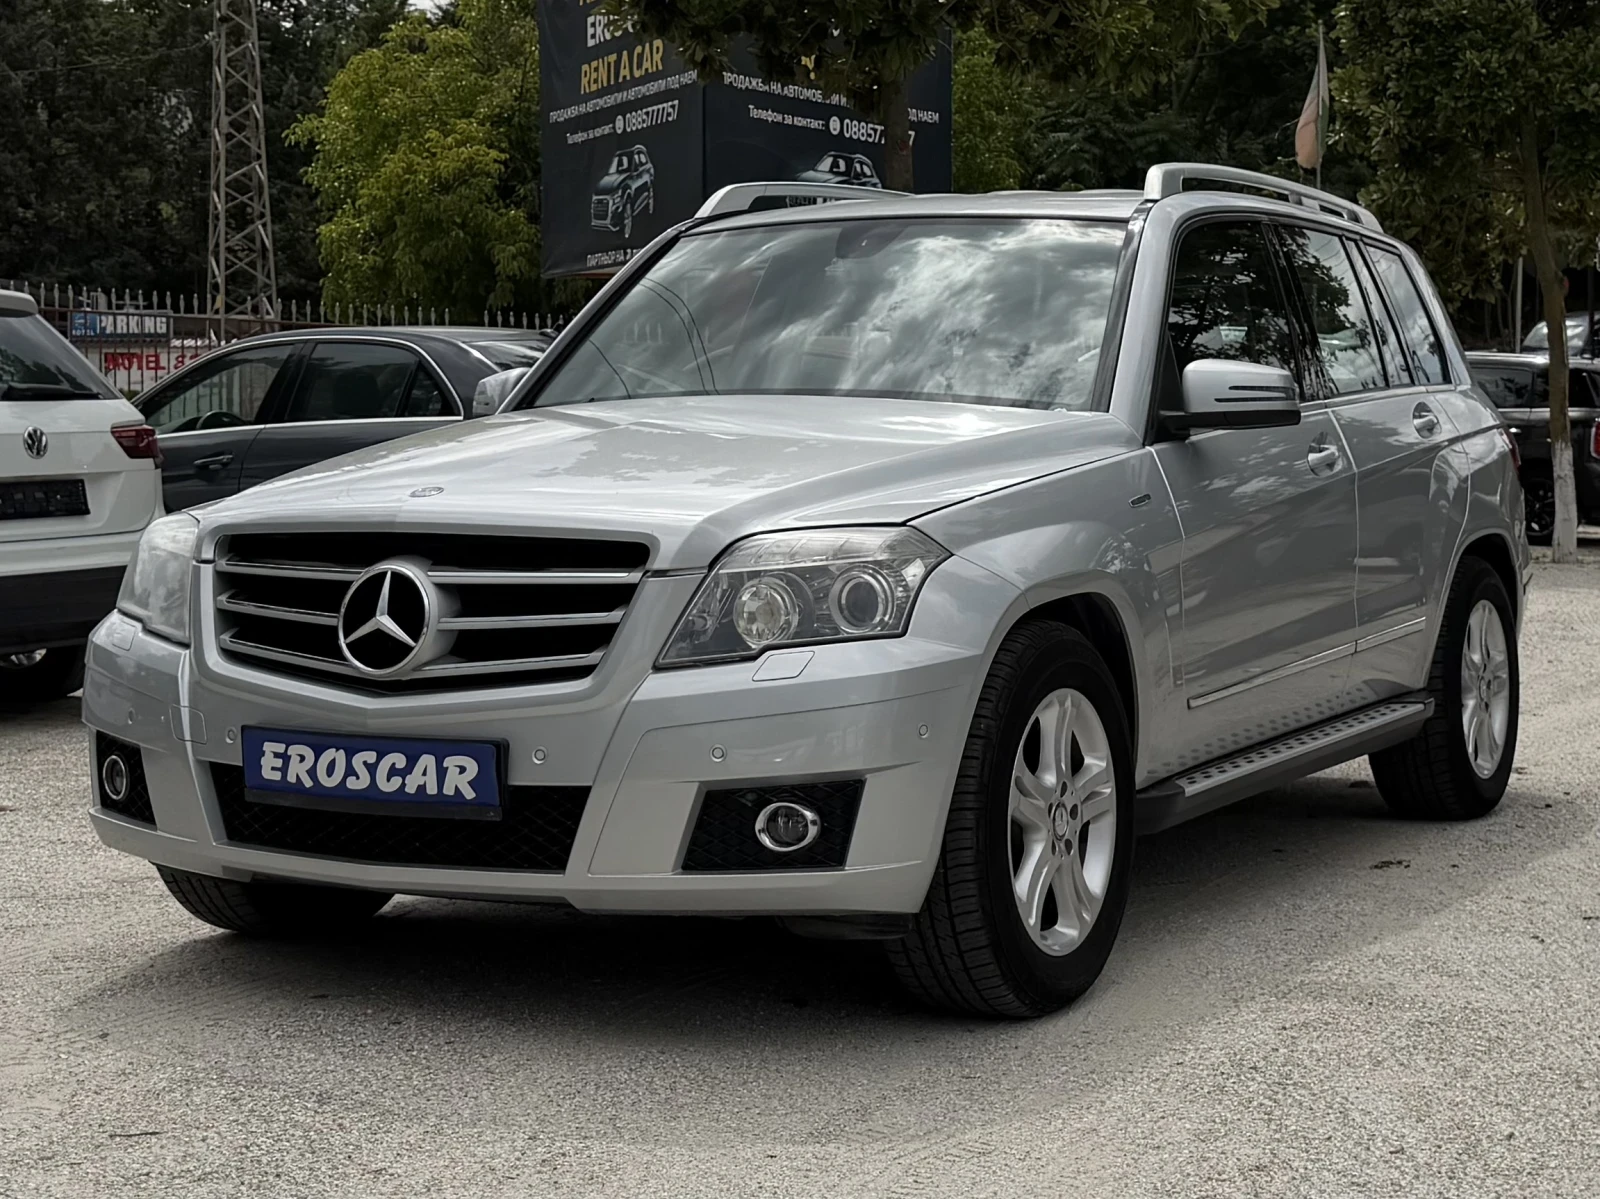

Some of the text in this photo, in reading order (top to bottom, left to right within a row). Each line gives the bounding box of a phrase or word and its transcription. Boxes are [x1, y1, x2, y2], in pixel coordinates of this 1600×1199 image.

[580, 38, 664, 95] RENT A CAR
[667, 74, 680, 89] ПОД
[680, 68, 698, 85] НАЕМ
[770, 81, 782, 95] НА
[625, 99, 679, 132] 0885777757
[748, 104, 783, 123] Телефон
[783, 114, 793, 125] за
[918, 109, 940, 124] НАЕМ
[96, 314, 167, 334] PARKING
[260, 741, 479, 801] EROSCAR
